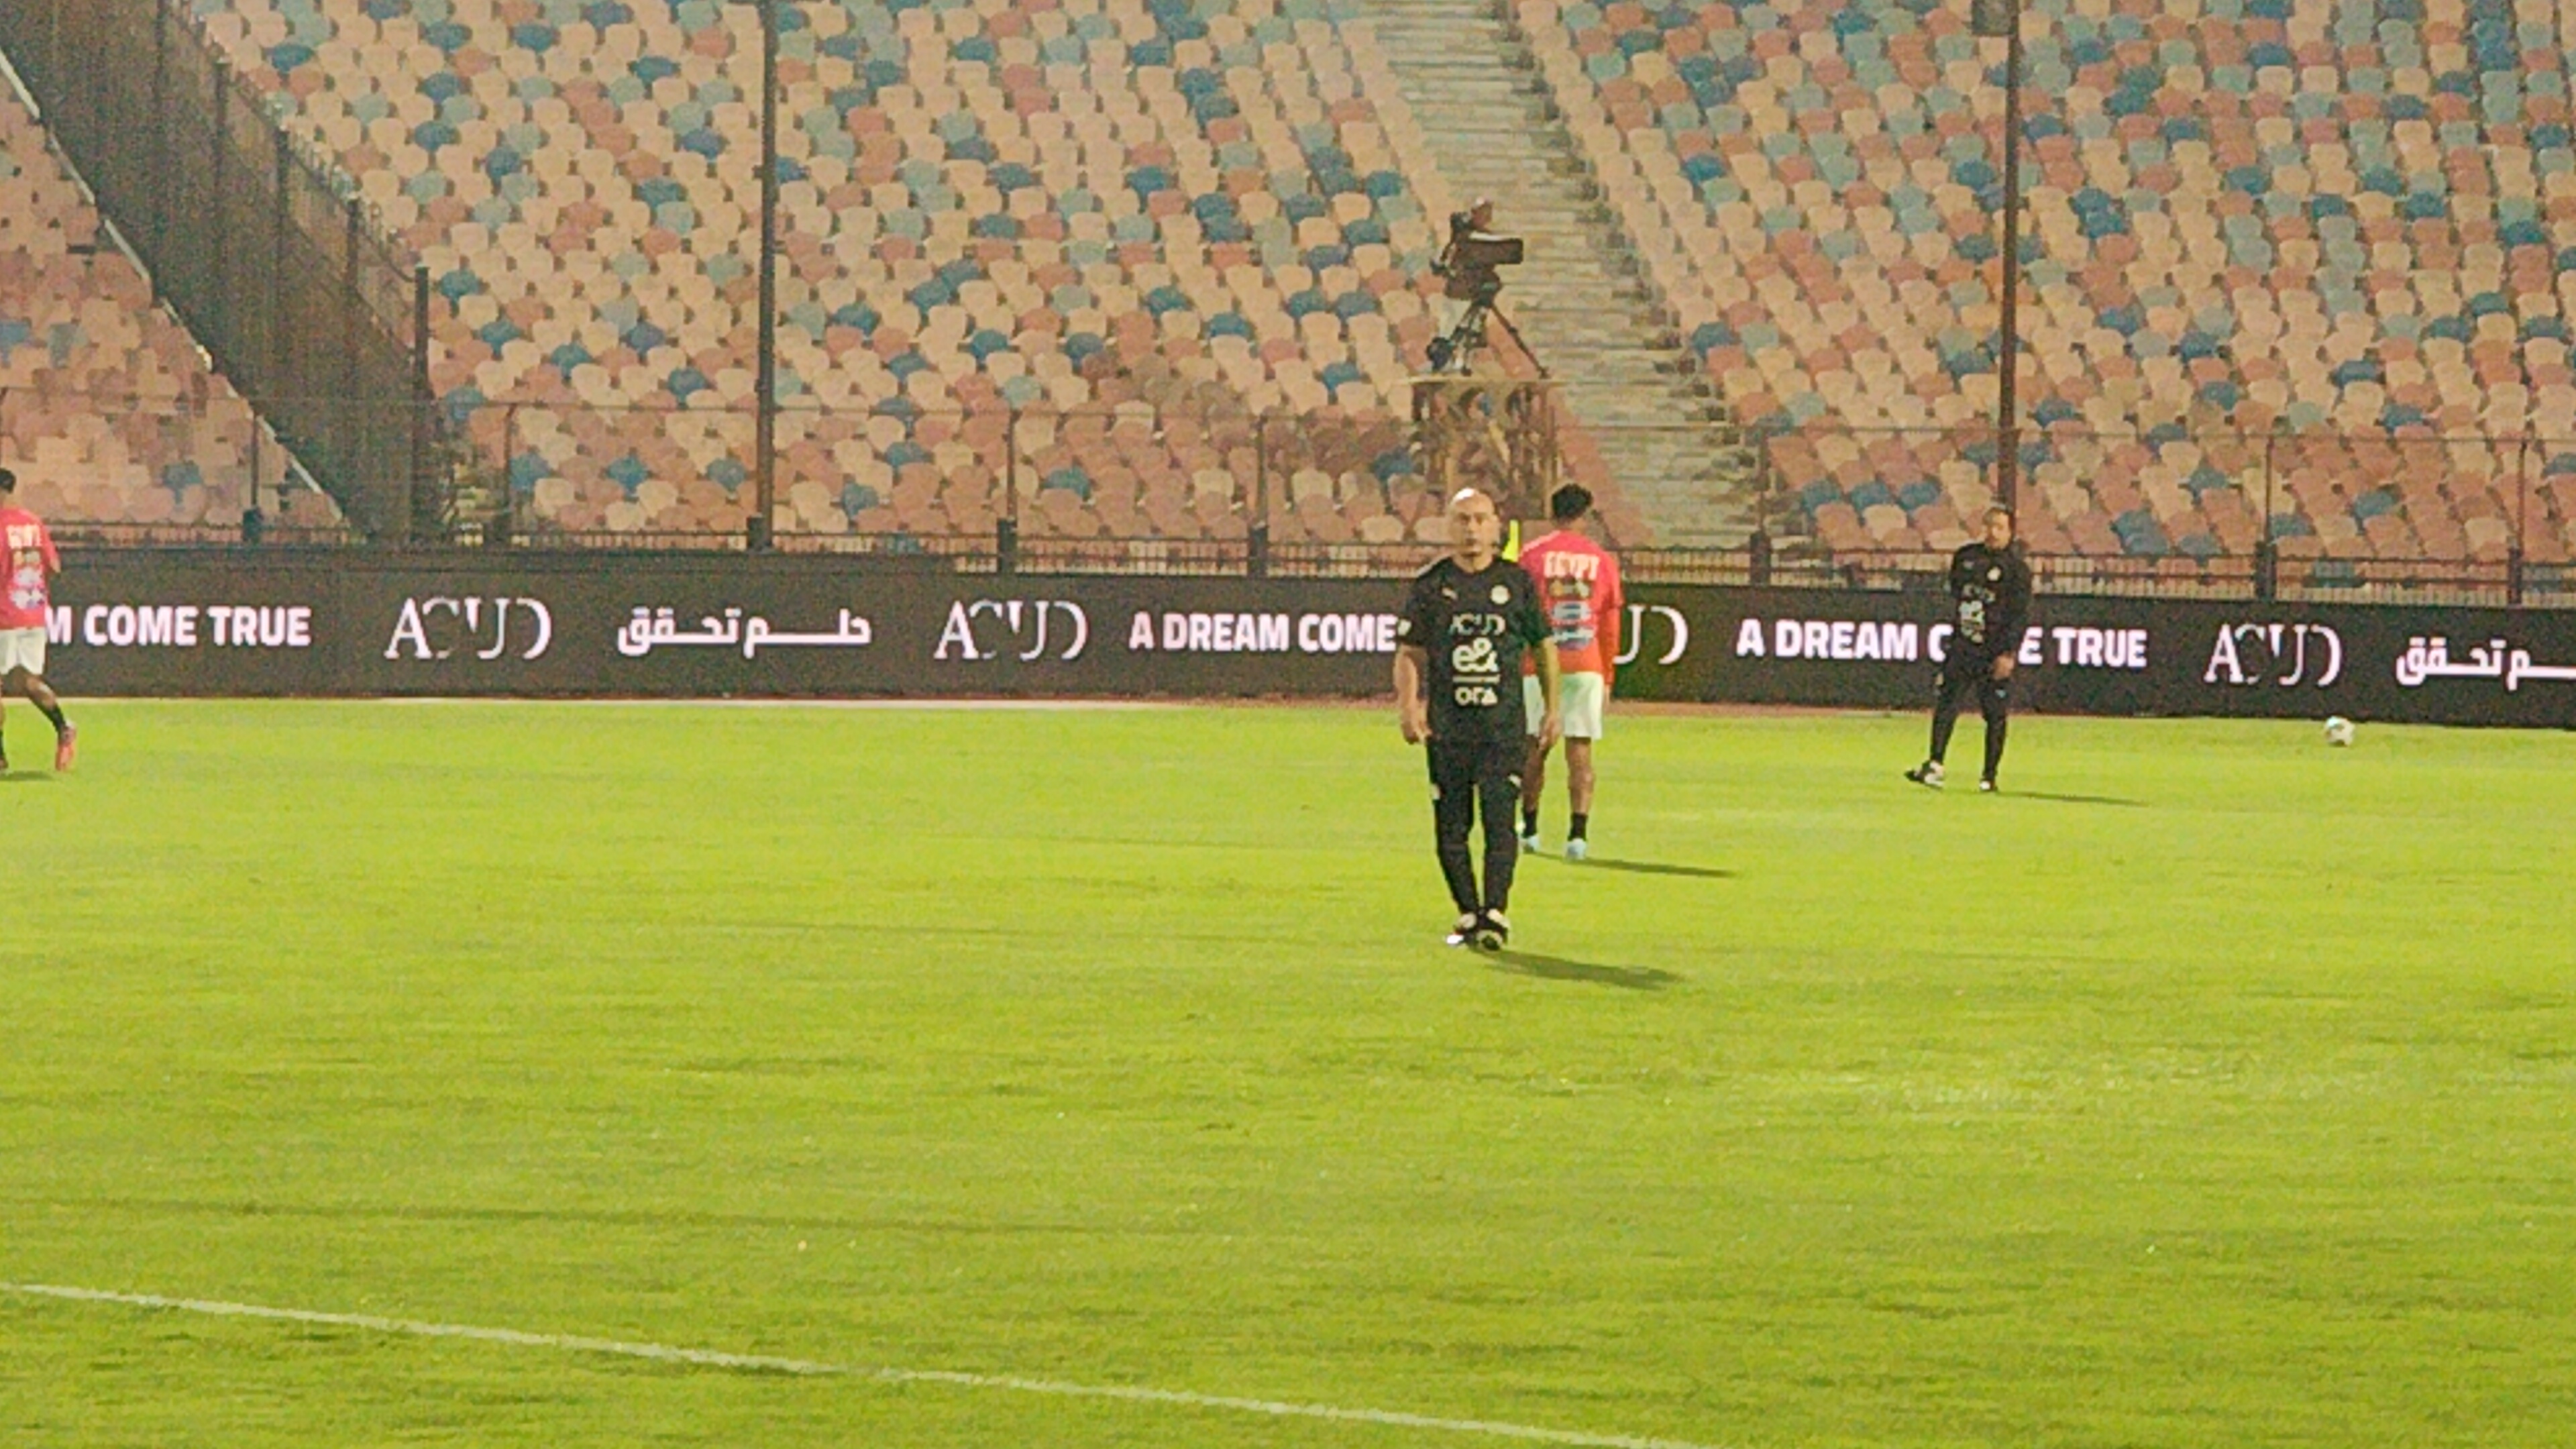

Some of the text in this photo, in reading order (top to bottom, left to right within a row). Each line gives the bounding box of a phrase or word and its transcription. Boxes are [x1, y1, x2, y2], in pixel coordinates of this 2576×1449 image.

[84, 605, 199, 646] COME
[207, 606, 311, 646] TRUE
[617, 607, 871, 659] حلم تحقق
[1129, 612, 1398, 652] A DREAM COME
[1736, 619, 1765, 657] A
[1775, 620, 1918, 661] DREAM
[1927, 623, 2043, 665] CE
[2052, 627, 2147, 667] TRUE
[2396, 637, 2506, 686] تحقق
